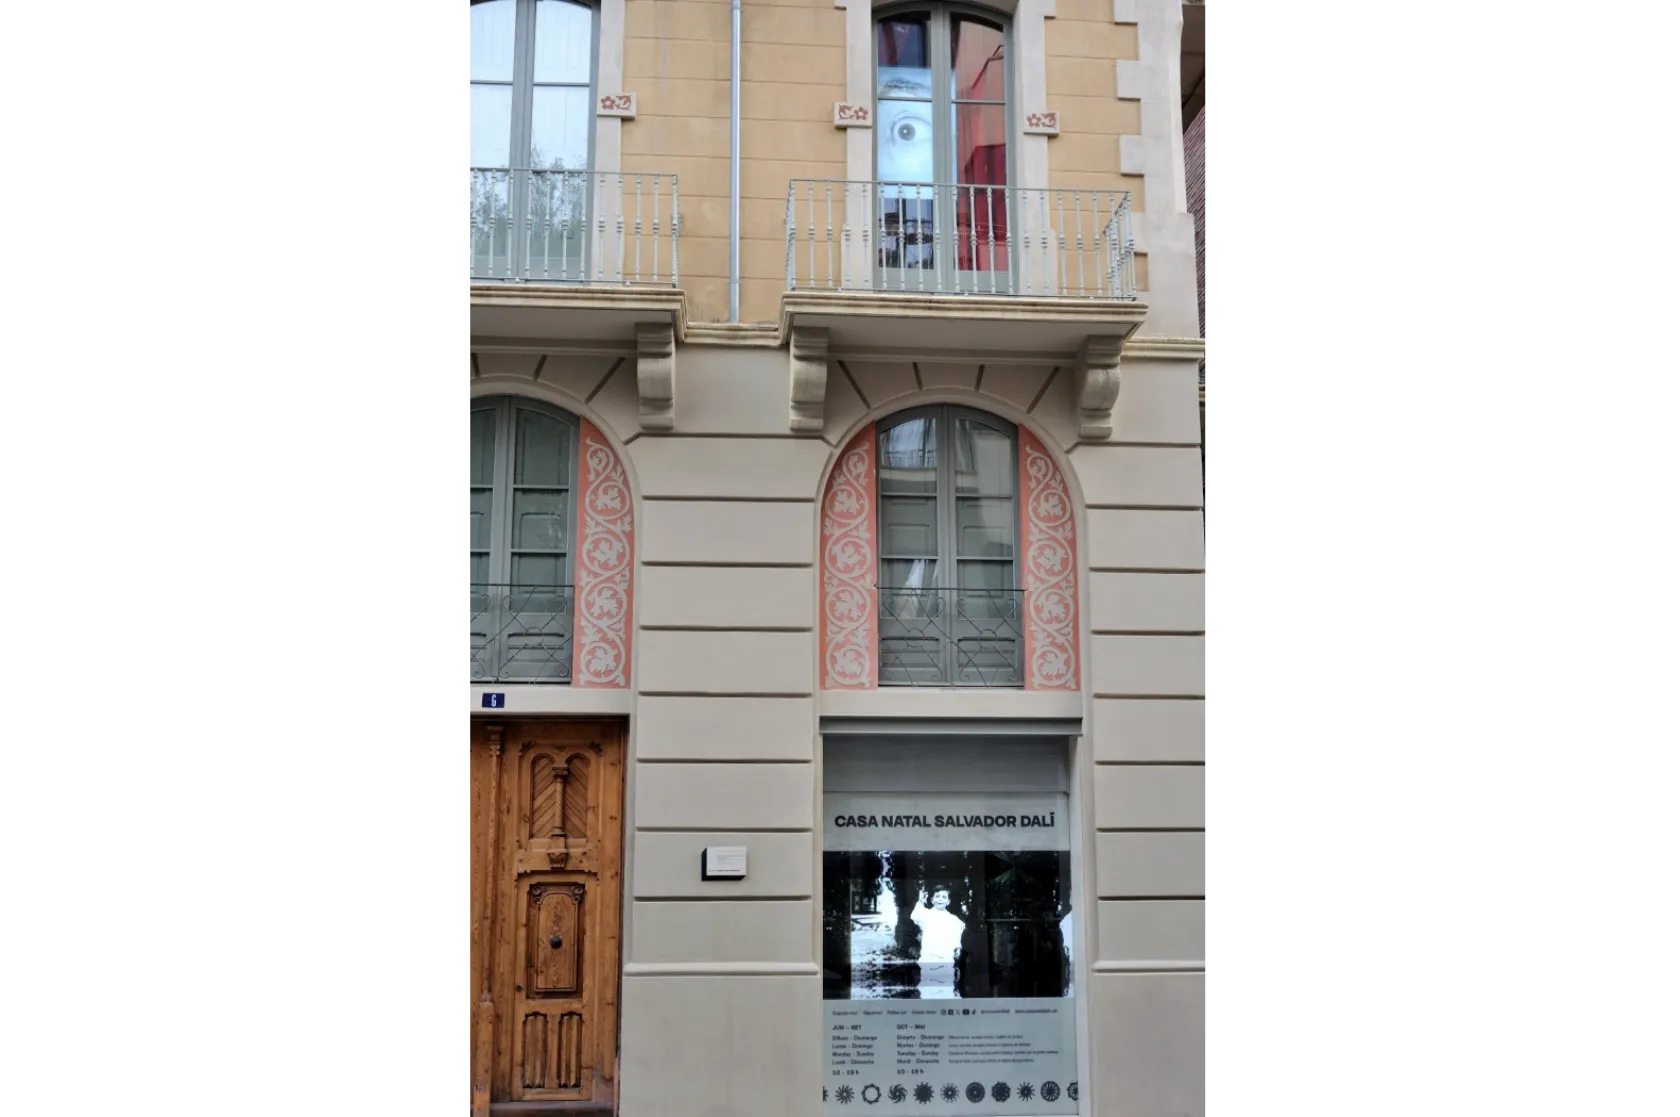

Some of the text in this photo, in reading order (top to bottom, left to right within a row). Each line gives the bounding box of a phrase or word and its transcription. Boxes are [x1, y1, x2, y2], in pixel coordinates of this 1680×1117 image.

[834, 812, 1055, 828] CASA NATAL SALVADOR DALÍ
